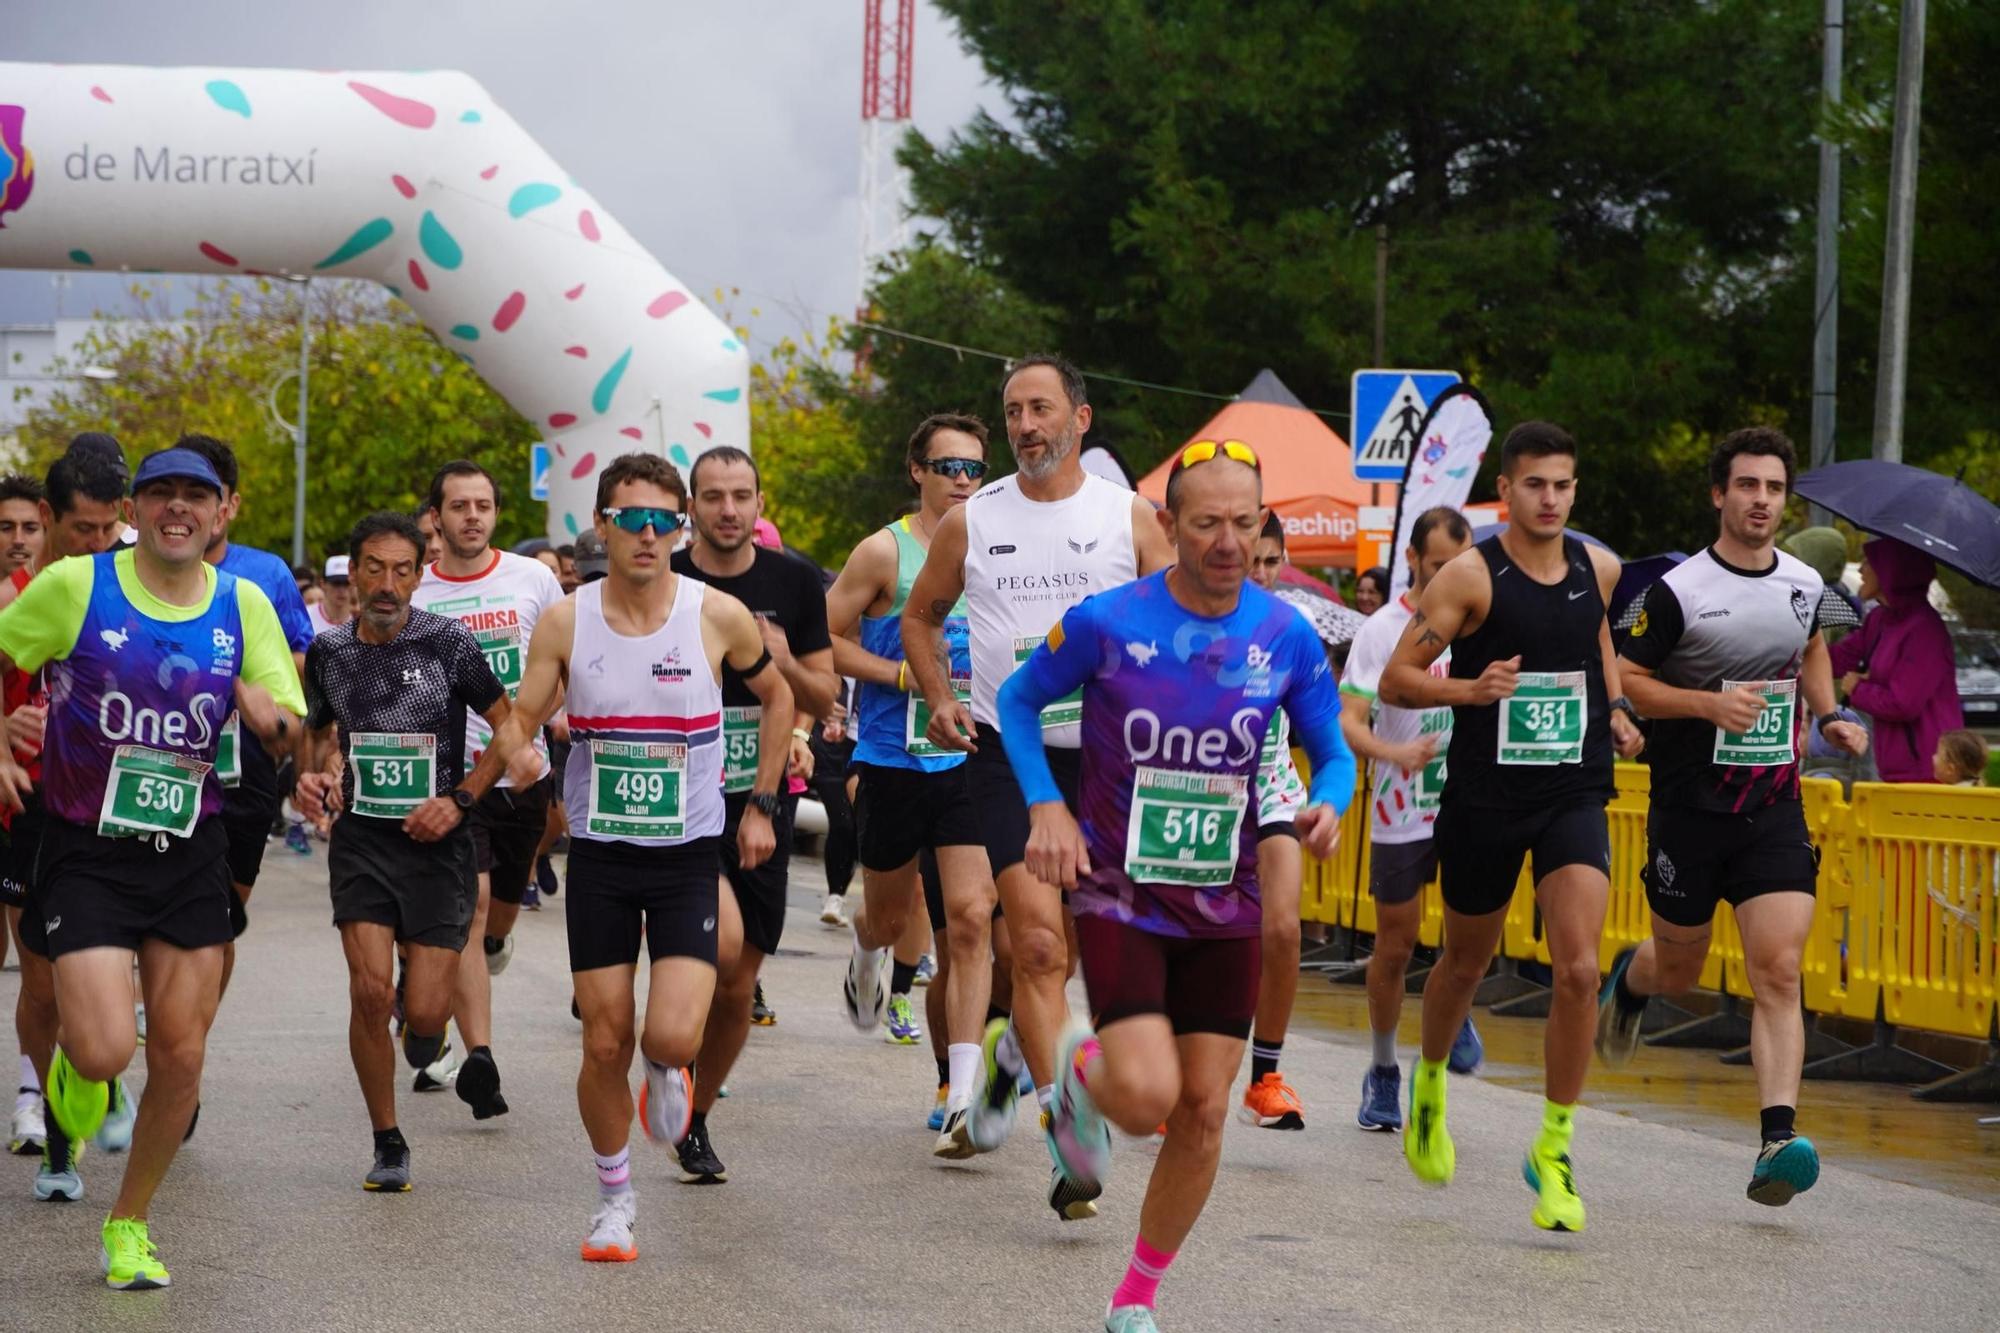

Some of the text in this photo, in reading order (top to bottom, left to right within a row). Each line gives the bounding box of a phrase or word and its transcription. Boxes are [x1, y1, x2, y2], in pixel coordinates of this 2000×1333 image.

[64, 143, 318, 186] de Marratxí
[996, 571, 1090, 590] PEGASUS
[1011, 592, 1078, 603] ATHLETIC CLUB
[460, 609, 519, 633] CURSA
[652, 668, 692, 677] MARATHON
[99, 690, 217, 750] OneS
[1525, 701, 1567, 731] 351
[604, 743, 629, 756] CURSA
[632, 745, 646, 757] DEL
[649, 745, 684, 758] SIURELL
[1124, 707, 1263, 767] OneS
[372, 760, 413, 786] 531
[135, 777, 184, 814] 530
[614, 772, 664, 803] 499
[625, 804, 649, 815] SALOM
[1163, 807, 1222, 845] 516
